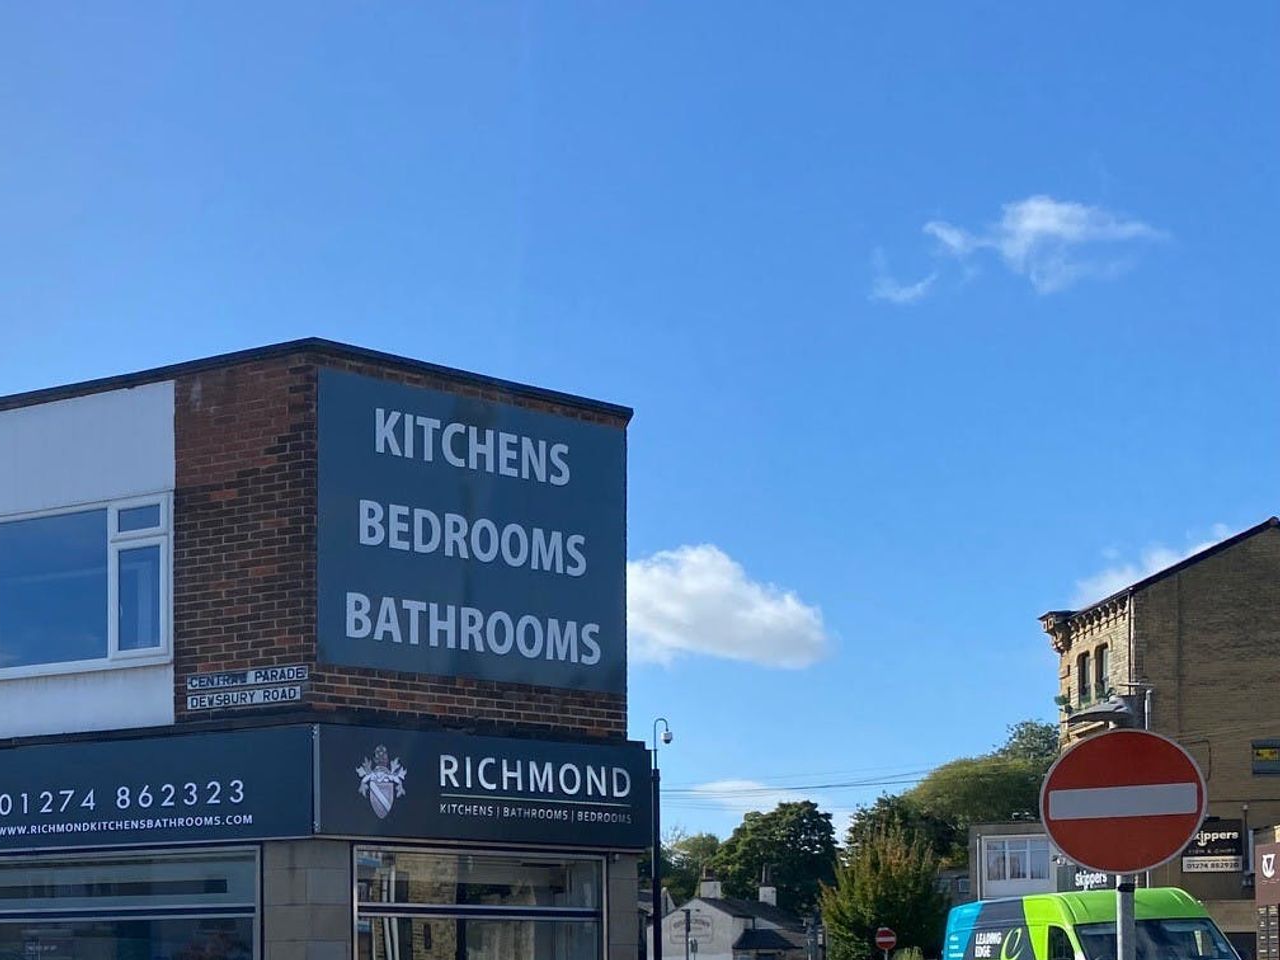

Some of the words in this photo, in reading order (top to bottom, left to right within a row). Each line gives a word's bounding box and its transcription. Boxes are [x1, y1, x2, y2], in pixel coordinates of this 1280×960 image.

[374, 408, 570, 486] KITCHENS
[359, 500, 587, 577] BEDROOMS
[346, 591, 601, 666] BATHROOMS
[254, 667, 305, 682] PARADE
[190, 691, 255, 708] DEWSBURY
[262, 687, 296, 701] ROAD
[440, 754, 632, 798] RICHMOND
[115, 779, 245, 809] 862323
[440, 803, 494, 817] KITCHENS
[503, 807, 568, 821] BATHROOMS
[577, 811, 632, 824] BEDROOMS
[975, 932, 1002, 945] LEADING
[975, 946, 992, 957] EDGE
